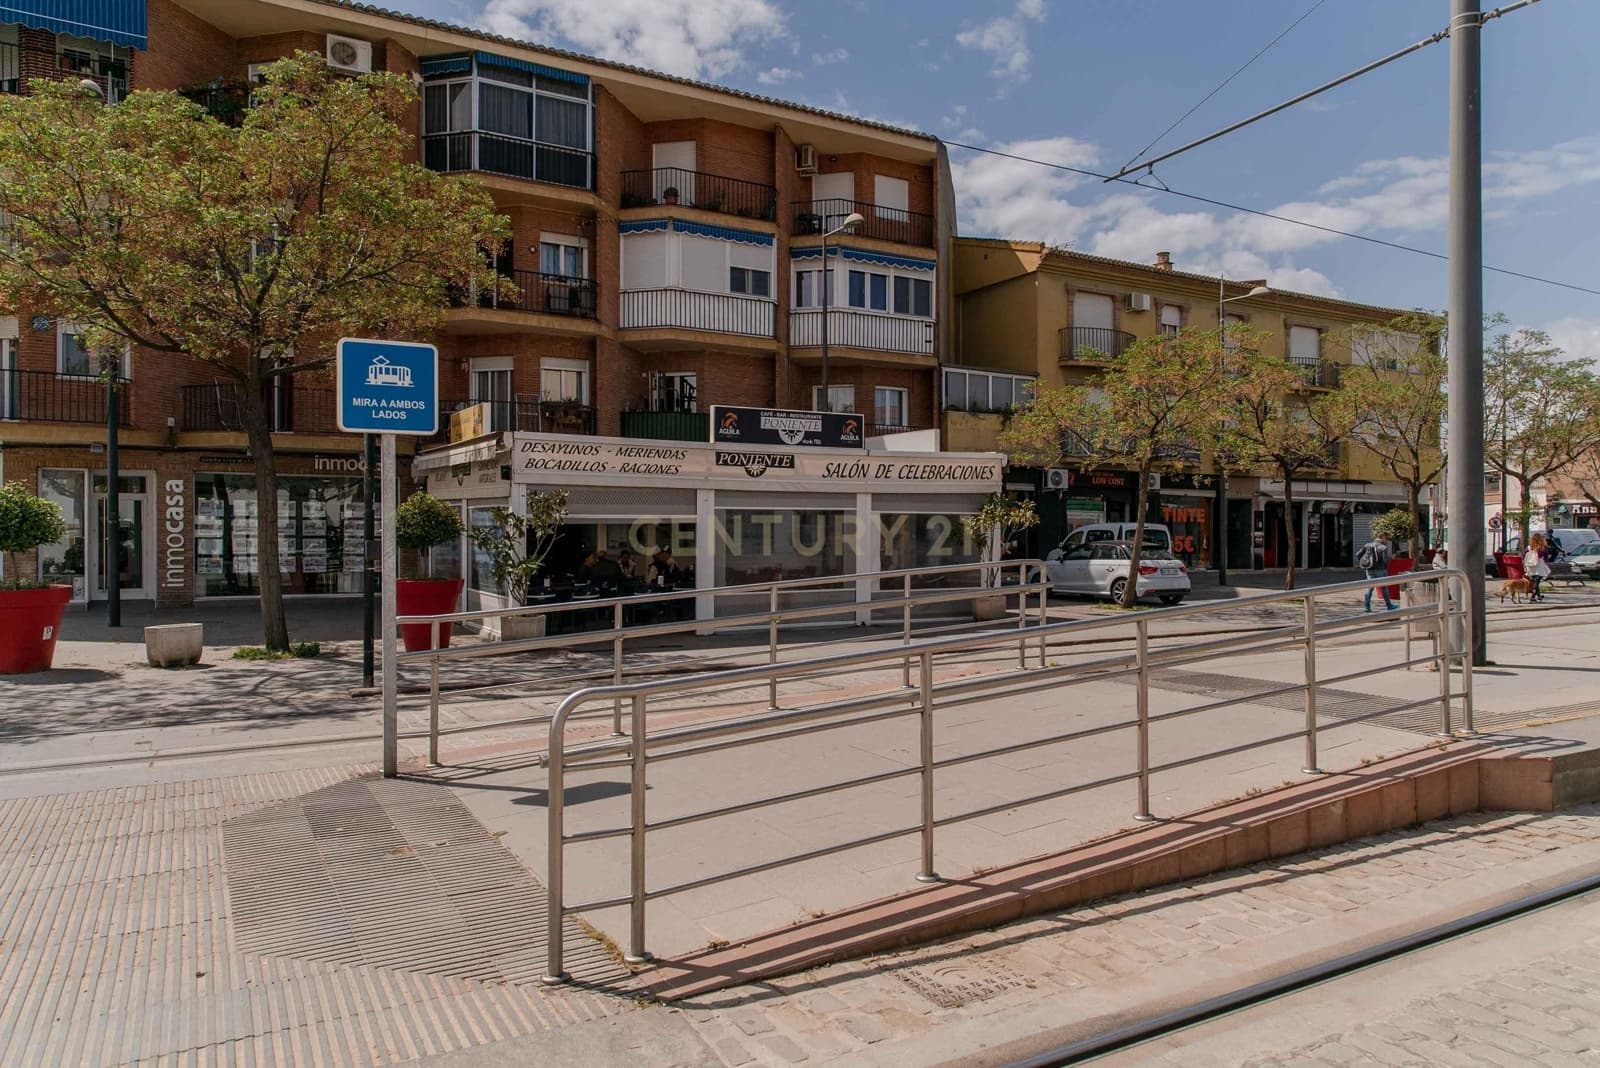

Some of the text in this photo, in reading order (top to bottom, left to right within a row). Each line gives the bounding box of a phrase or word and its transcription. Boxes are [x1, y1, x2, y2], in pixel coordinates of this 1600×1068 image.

[352, 397, 426, 410] MIRA A AMBOS
[372, 409, 407, 420] LADOS
[762, 417, 821, 431] PONIENTE
[520, 441, 602, 456] DESAYUNOS
[615, 446, 688, 461] MERIENDAS
[524, 457, 609, 473] BOCADILLOS
[618, 462, 682, 475] RACIONES
[718, 453, 792, 468] PONIENTE
[822, 459, 996, 481] SALÓN DE CELEBRACIONES
[1162, 506, 1206, 522] TINTE
[162, 479, 185, 587] inmocasa
